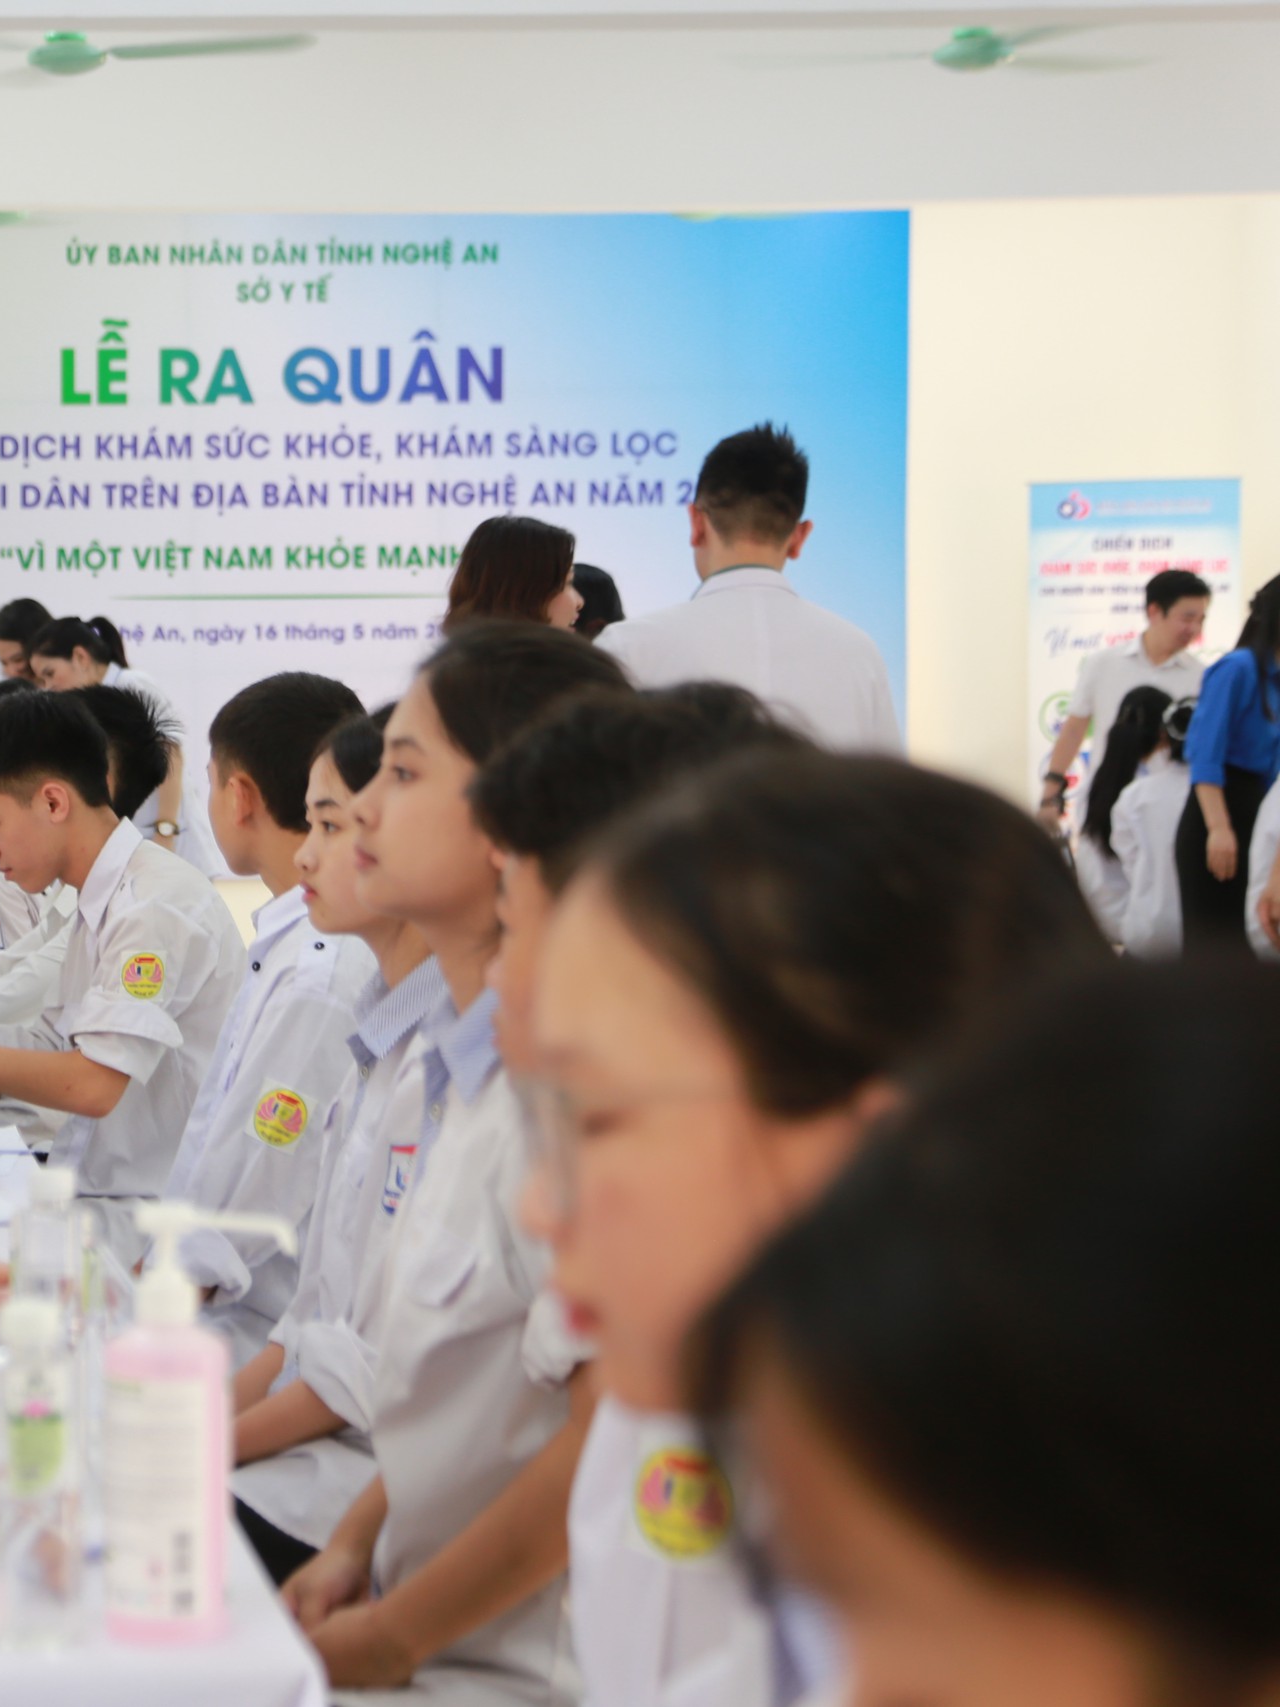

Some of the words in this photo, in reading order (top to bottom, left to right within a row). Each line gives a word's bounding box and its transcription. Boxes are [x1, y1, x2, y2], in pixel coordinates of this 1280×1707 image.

[66, 237, 98, 265] ỦY
[107, 245, 160, 265] BAN
[169, 239, 243, 265] NHÂN
[253, 238, 307, 265] DÂN
[316, 237, 373, 265] TỈNH
[383, 237, 453, 271] NGHỆ
[462, 244, 499, 264] AN
[236, 275, 272, 303] SỞ
[280, 281, 295, 303] Y
[303, 272, 333, 303] TẾ
[60, 318, 129, 405] LỄ
[159, 347, 255, 405] RA
[283, 328, 504, 405] QUÂN
[95, 426, 193, 460] KHÁM
[205, 425, 271, 460] SỨC
[284, 423, 381, 464] KHỎE,
[396, 425, 493, 459] KHÁM
[505, 424, 598, 458] SÀNG
[611, 430, 678, 466] LỌC
[20, 476, 90, 510] DÂN
[103, 475, 179, 509] TRÊN
[193, 482, 249, 516] ĐỊA
[263, 474, 328, 508] BÀN
[341, 472, 413, 507] TỈNH
[427, 473, 517, 516] NGHỆ
[530, 481, 575, 506] AN
[589, 474, 663, 506] NĂM
[56, 539, 122, 578] MỘT
[133, 539, 192, 578] VIỆT
[204, 546, 272, 570] NAM
[285, 537, 366, 570] KHỎE
[152, 625, 186, 644] An,
[193, 624, 246, 645] ngày
[255, 624, 277, 641] 16
[284, 622, 346, 645] tháng
[353, 624, 364, 641] 5
[372, 622, 418, 641] năm
